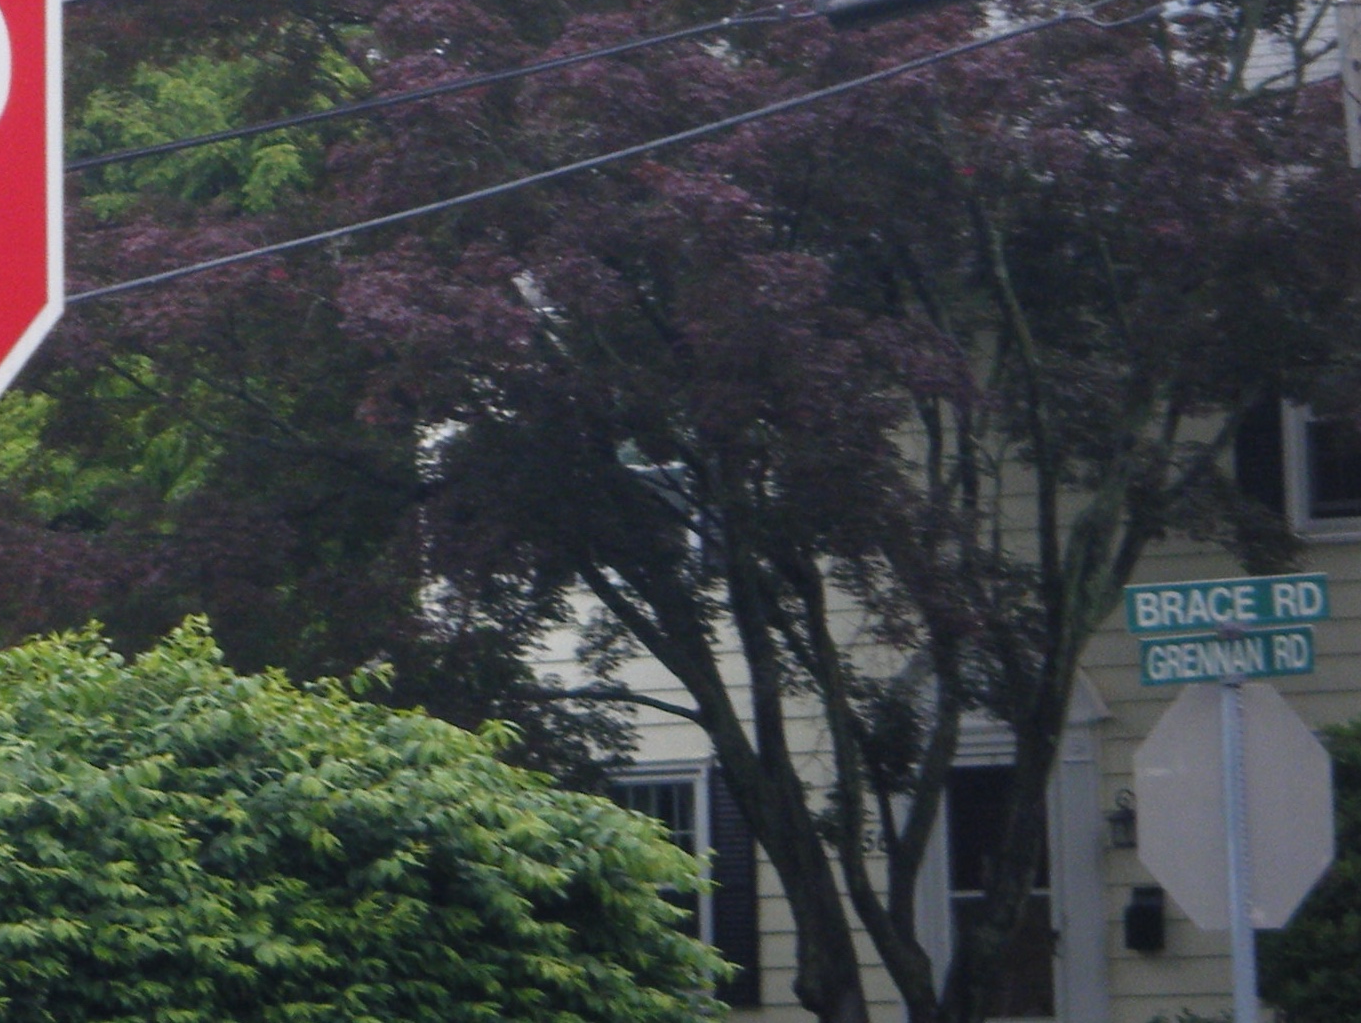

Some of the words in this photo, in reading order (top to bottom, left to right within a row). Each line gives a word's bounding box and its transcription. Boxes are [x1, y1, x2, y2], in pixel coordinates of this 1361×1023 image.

[1136, 585, 1257, 627] BRACE
[1274, 582, 1323, 617] RD
[1147, 637, 1265, 680] GRENNAN
[1273, 634, 1308, 669] RD
